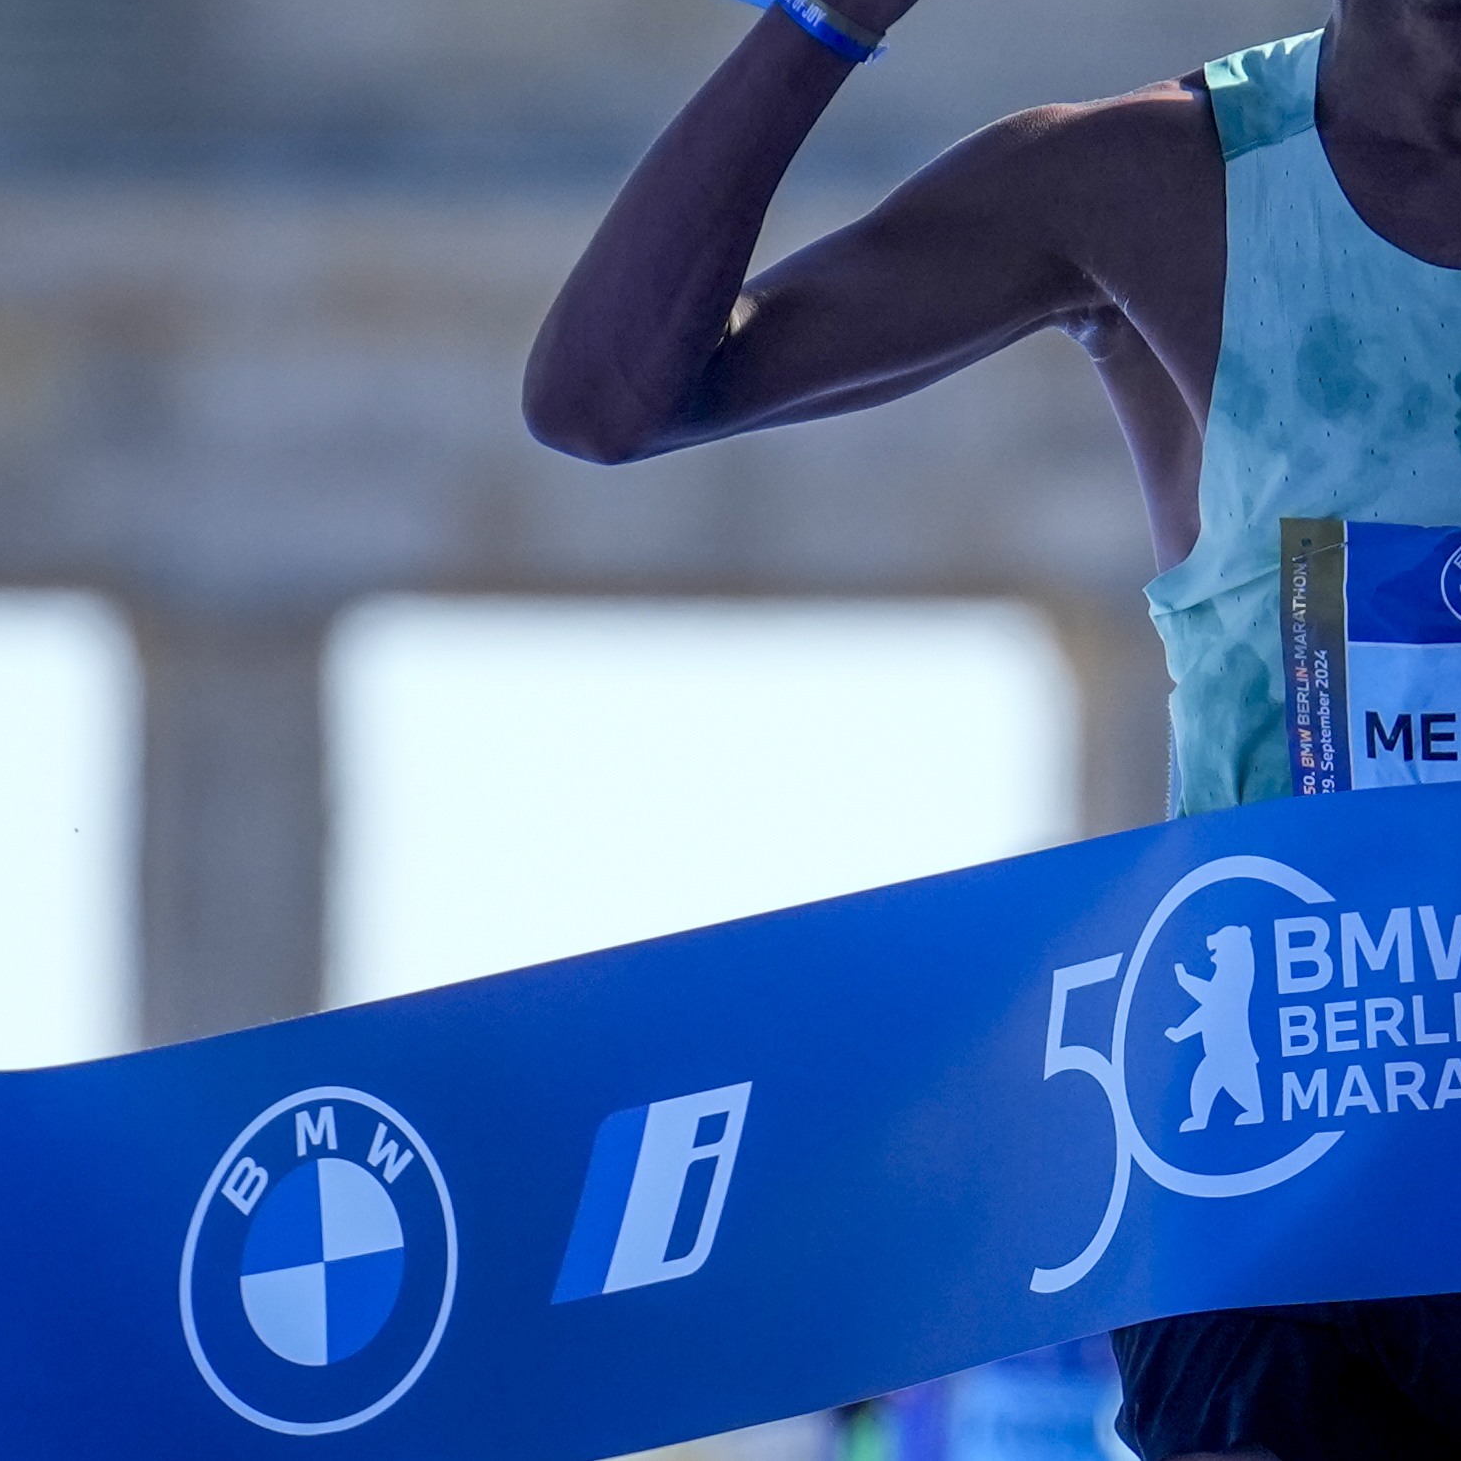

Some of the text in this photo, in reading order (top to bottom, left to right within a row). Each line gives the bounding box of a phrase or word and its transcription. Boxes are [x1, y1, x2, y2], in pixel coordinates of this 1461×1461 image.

[801, 2, 827, 27] JOY
[1314, 649, 1330, 689] 2024
[1298, 728, 1315, 769] BMW
[1317, 691, 1336, 772] September
[221, 1105, 415, 1216] BMW
